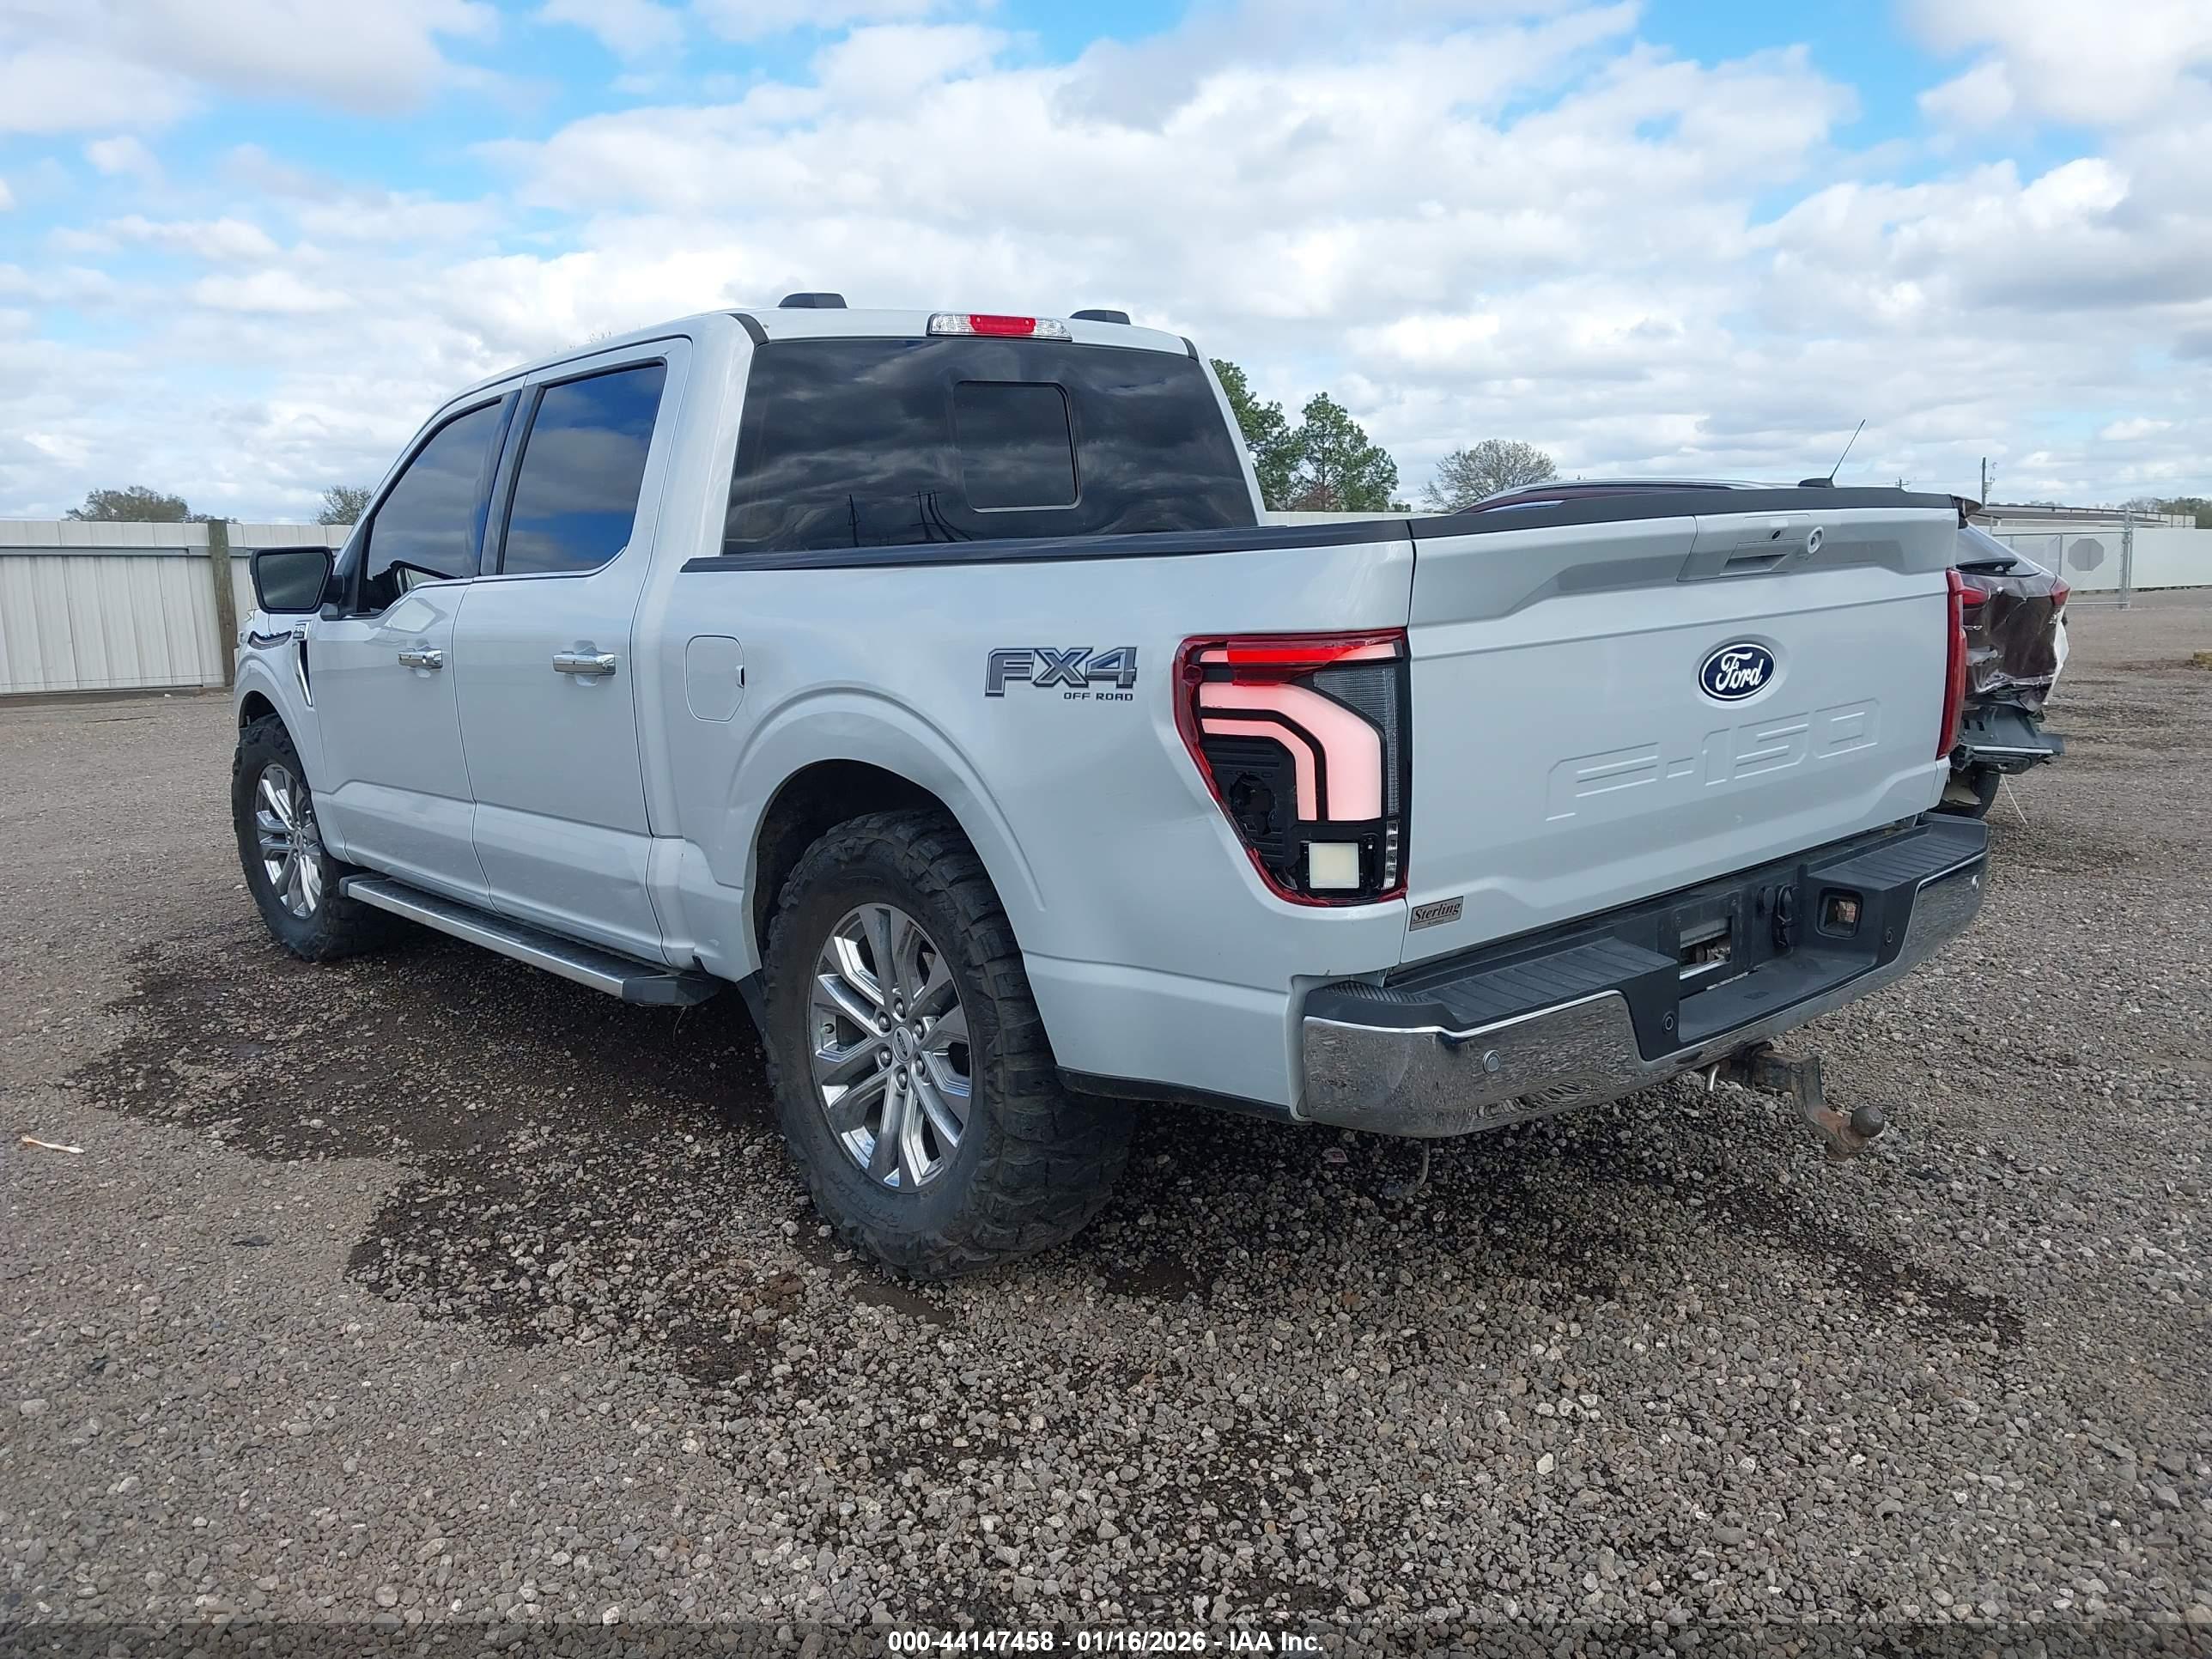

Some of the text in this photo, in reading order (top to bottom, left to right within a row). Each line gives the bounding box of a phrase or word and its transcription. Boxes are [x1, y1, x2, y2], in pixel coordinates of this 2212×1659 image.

[985, 647, 1138, 697] FX4
[1715, 652, 1765, 691] Ford
[1063, 691, 1133, 702] OFF ROAD
[1546, 697, 1881, 822] F-150
[1413, 902, 1462, 921] Sterling
